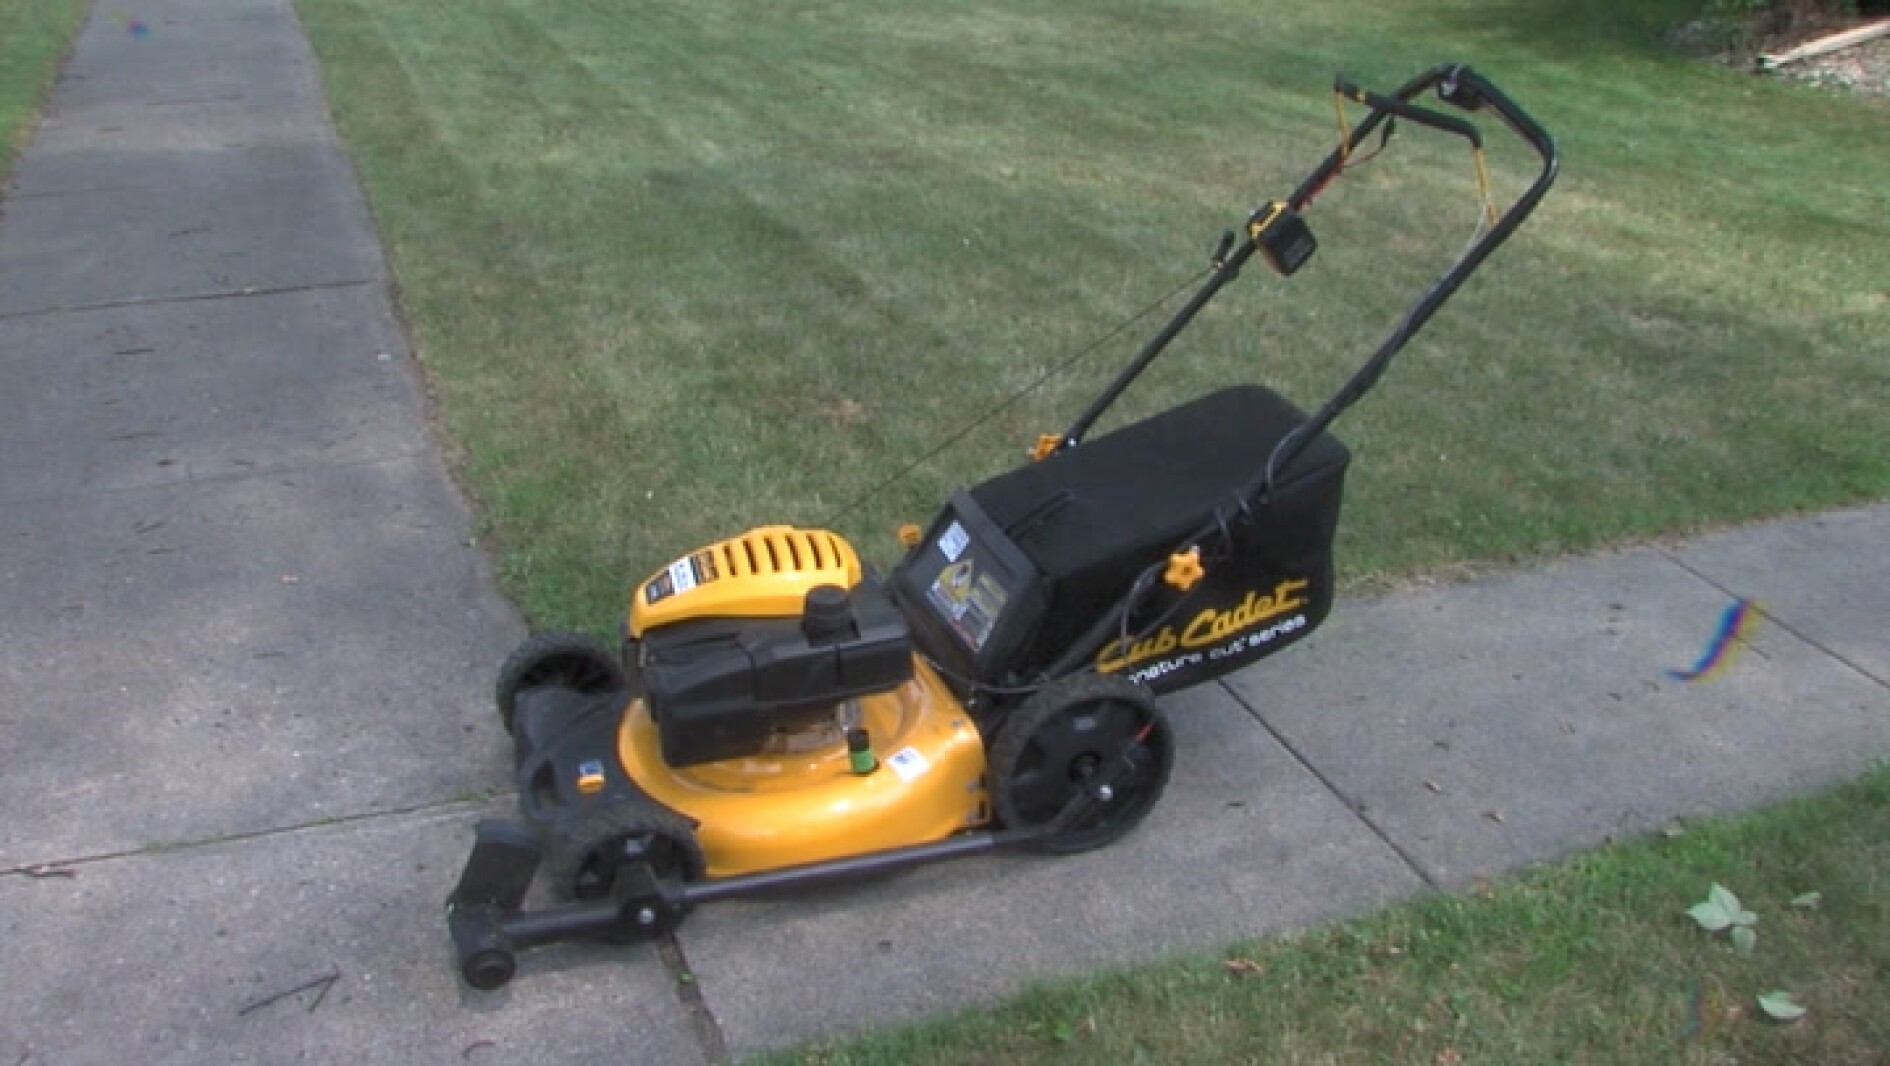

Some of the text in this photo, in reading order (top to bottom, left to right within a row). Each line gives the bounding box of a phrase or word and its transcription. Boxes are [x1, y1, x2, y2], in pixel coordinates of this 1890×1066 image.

[1096, 578, 1309, 674] Cub Cadet
[1248, 614, 1306, 647] series
